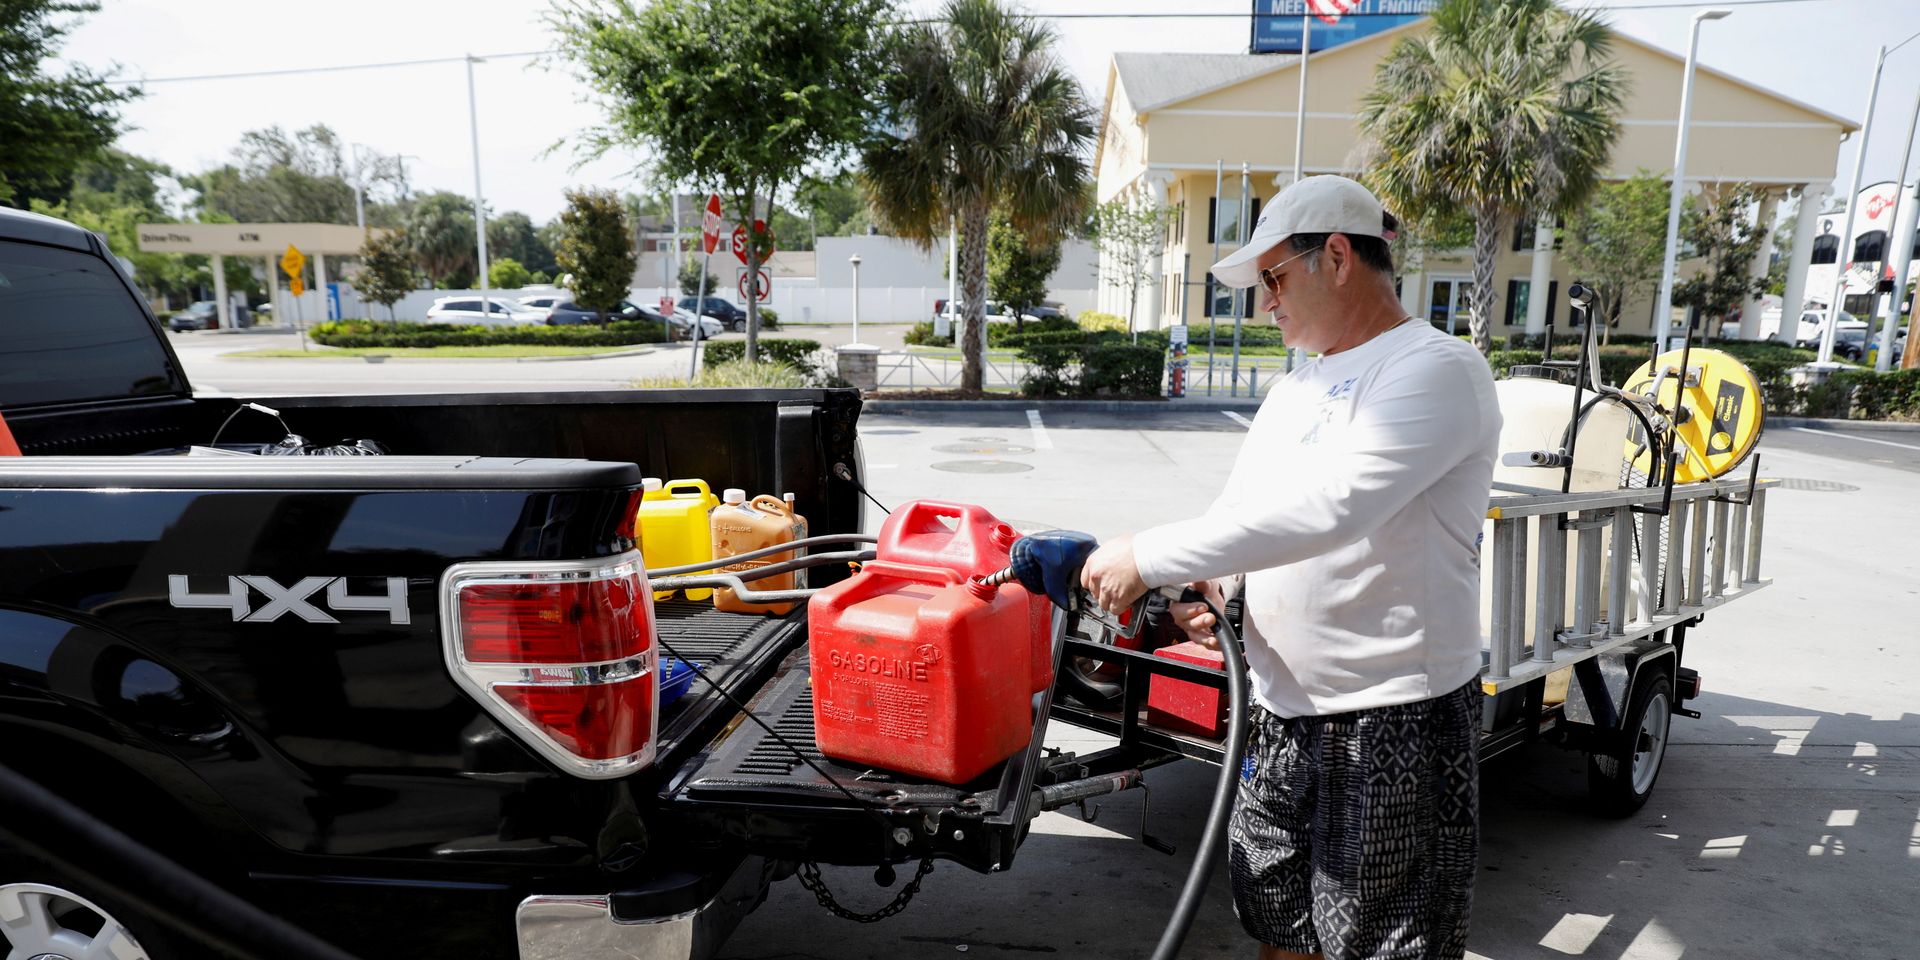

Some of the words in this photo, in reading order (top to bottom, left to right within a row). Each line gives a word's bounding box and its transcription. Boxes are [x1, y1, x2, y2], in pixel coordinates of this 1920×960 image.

[1271, 0, 1305, 15] MEE
[168, 574, 411, 625] 4X4
[829, 649, 929, 682] GASOLINE
